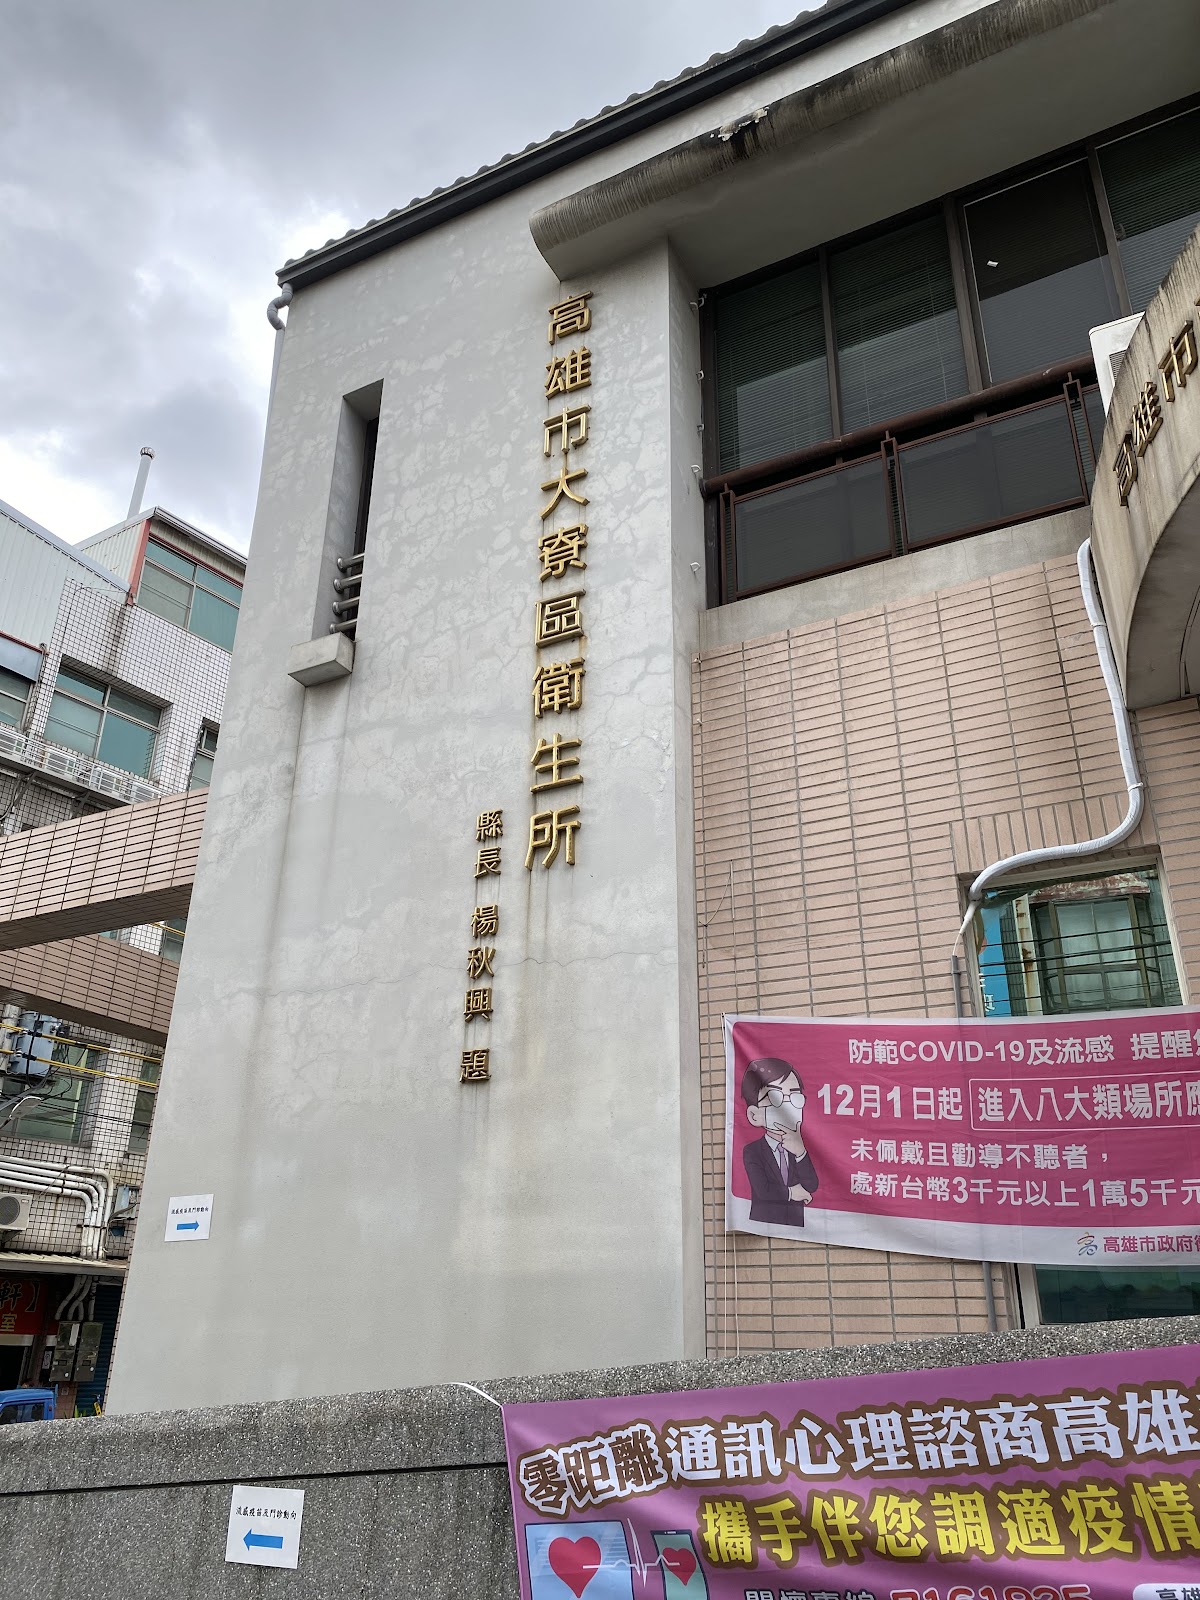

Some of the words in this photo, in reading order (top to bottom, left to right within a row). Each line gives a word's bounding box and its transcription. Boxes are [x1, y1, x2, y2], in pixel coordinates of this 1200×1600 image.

[1113, 295, 1200, 506] 高雄市
[524, 290, 594, 871] 高雄市大寮區衛生所
[473, 809, 503, 878] 縣長
[463, 904, 500, 1022] 楊秋興
[459, 1048, 492, 1083] 題
[848, 1035, 1115, 1065] 防範COVID-19及流感
[1130, 1028, 1200, 1061] 提醒
[817, 1083, 963, 1121] 12月1日起
[851, 1138, 1108, 1170] 未佩戴且勸導不聽者，
[850, 1171, 1200, 1208] 處新台幣3千元以上1萬5千元
[520, 1388, 1200, 1514] 零距離通訊心理諮商高雄
[702, 1480, 1200, 1563] 攜手伴您調適疫情
